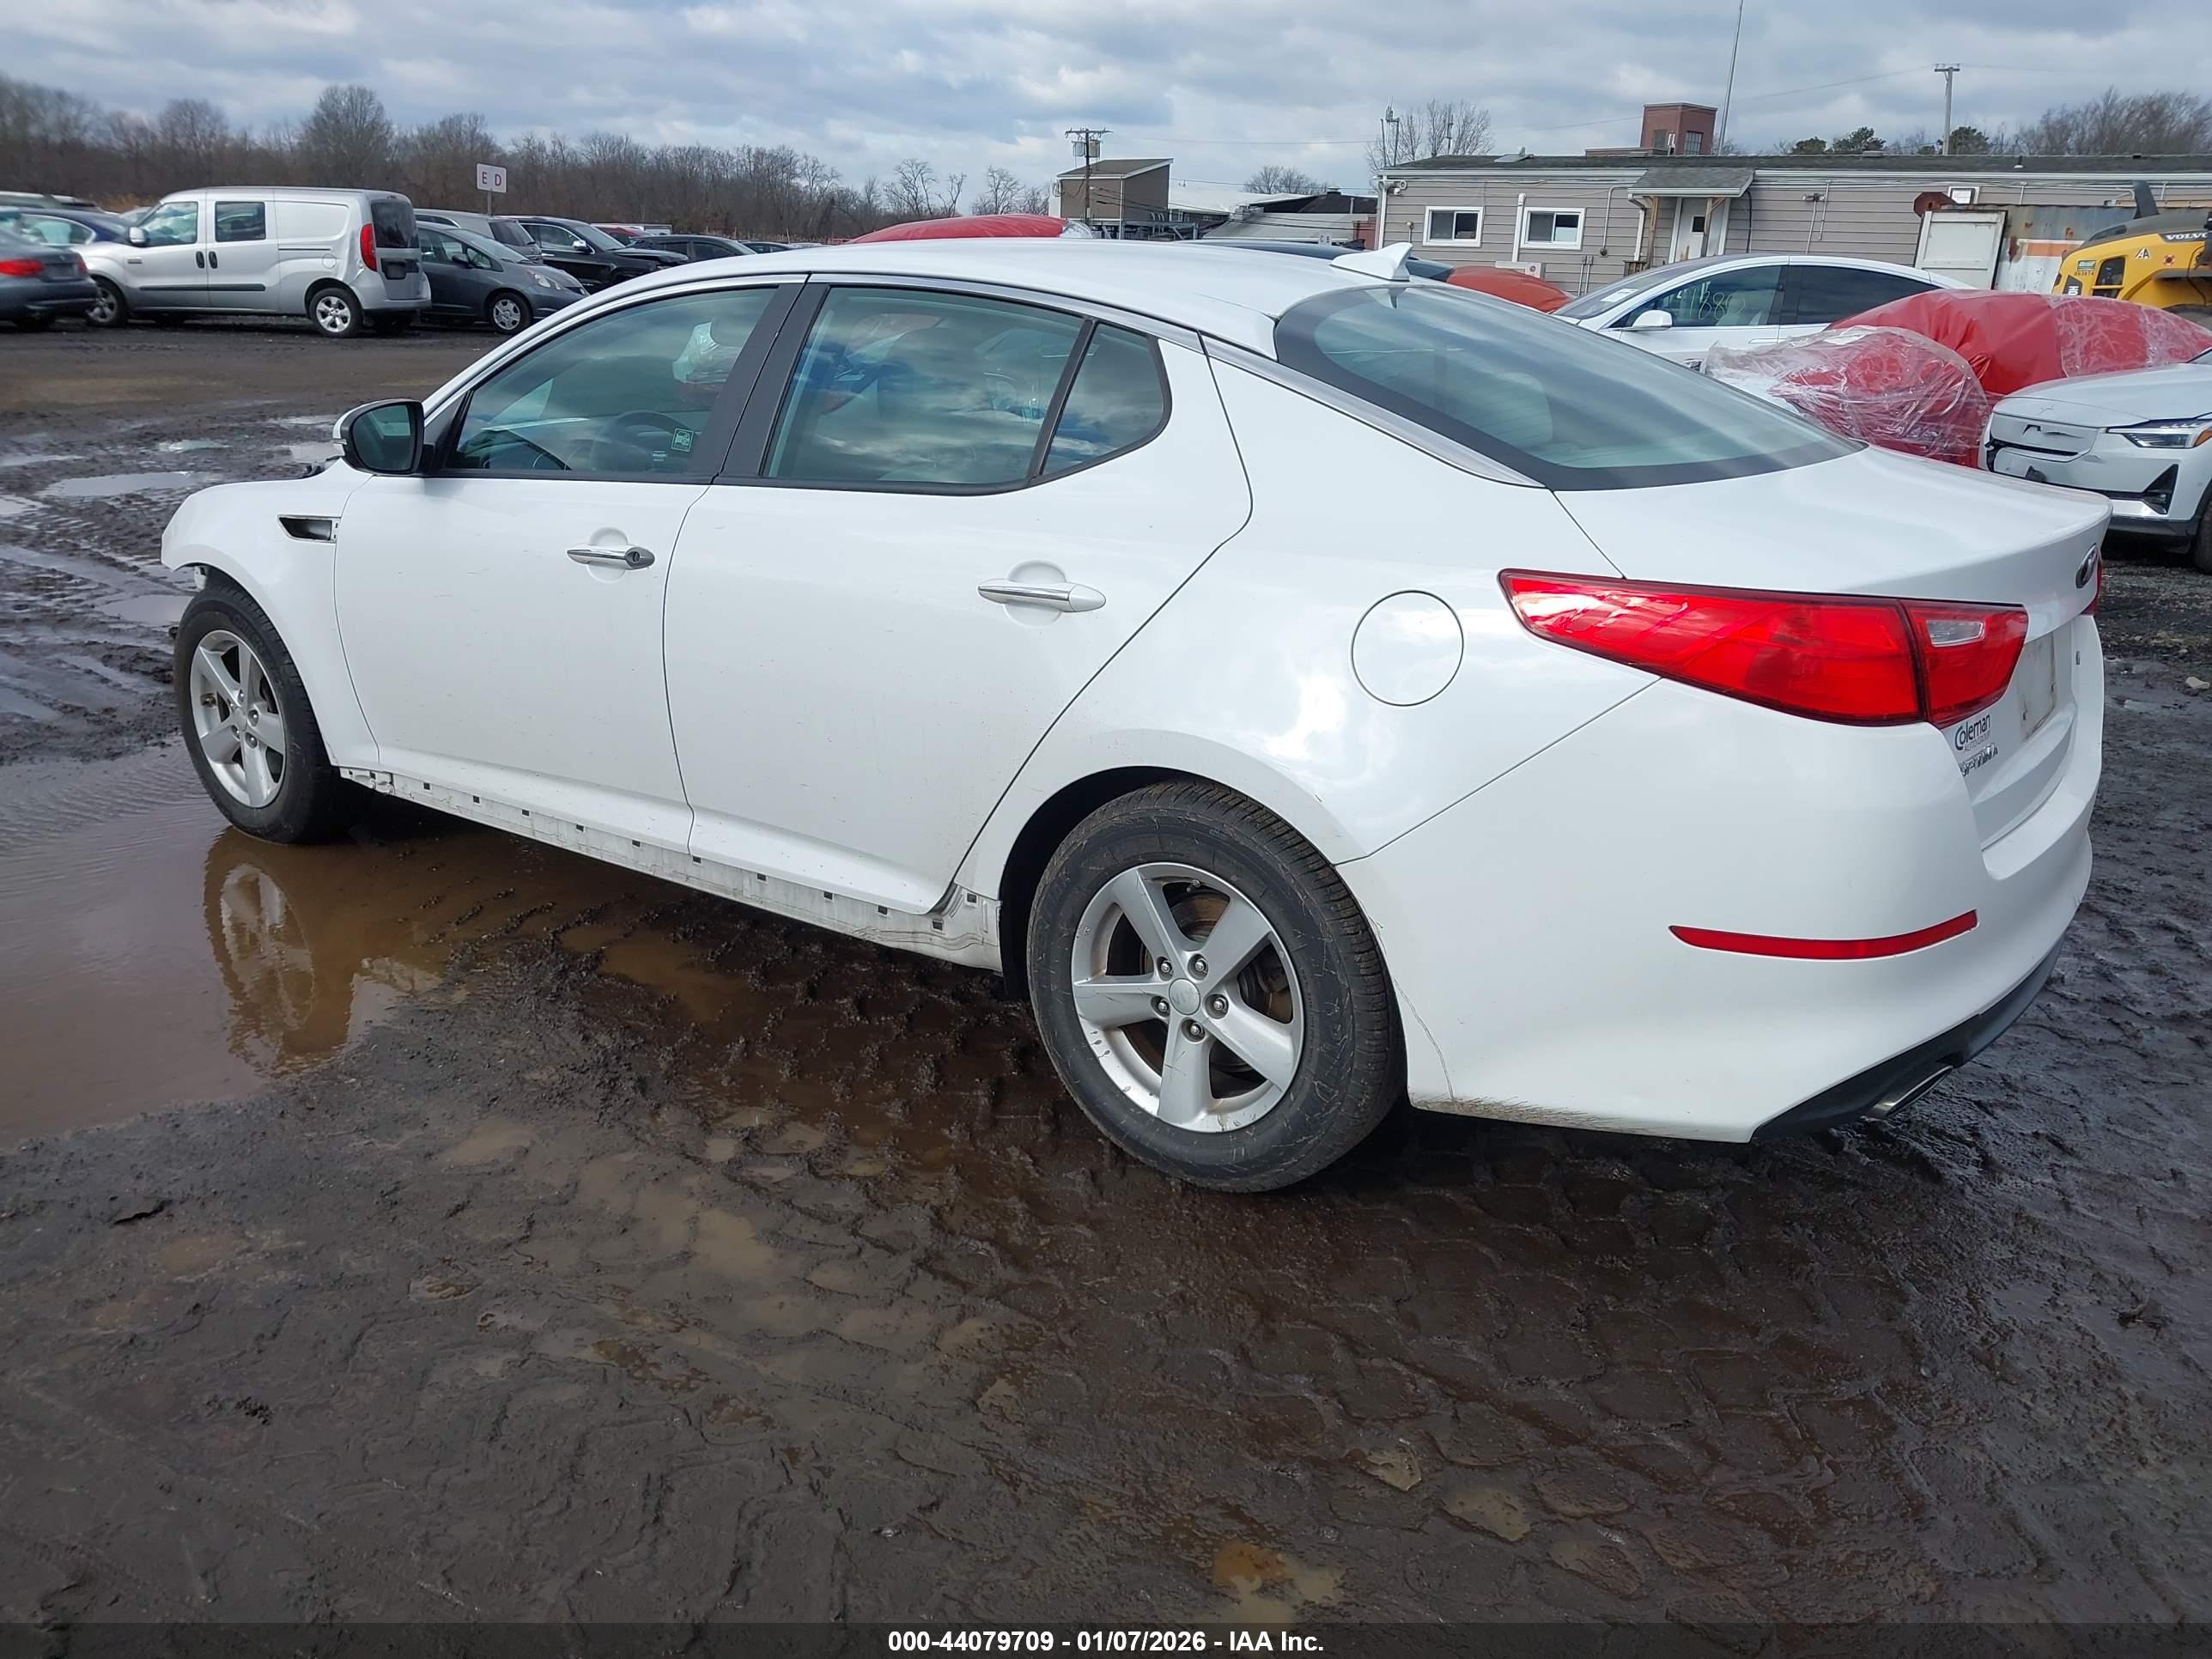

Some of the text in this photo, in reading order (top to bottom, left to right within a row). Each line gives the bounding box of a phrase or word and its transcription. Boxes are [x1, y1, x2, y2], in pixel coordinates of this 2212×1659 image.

[482, 172, 502, 186] E D
[1954, 714, 1990, 750] Coleman
